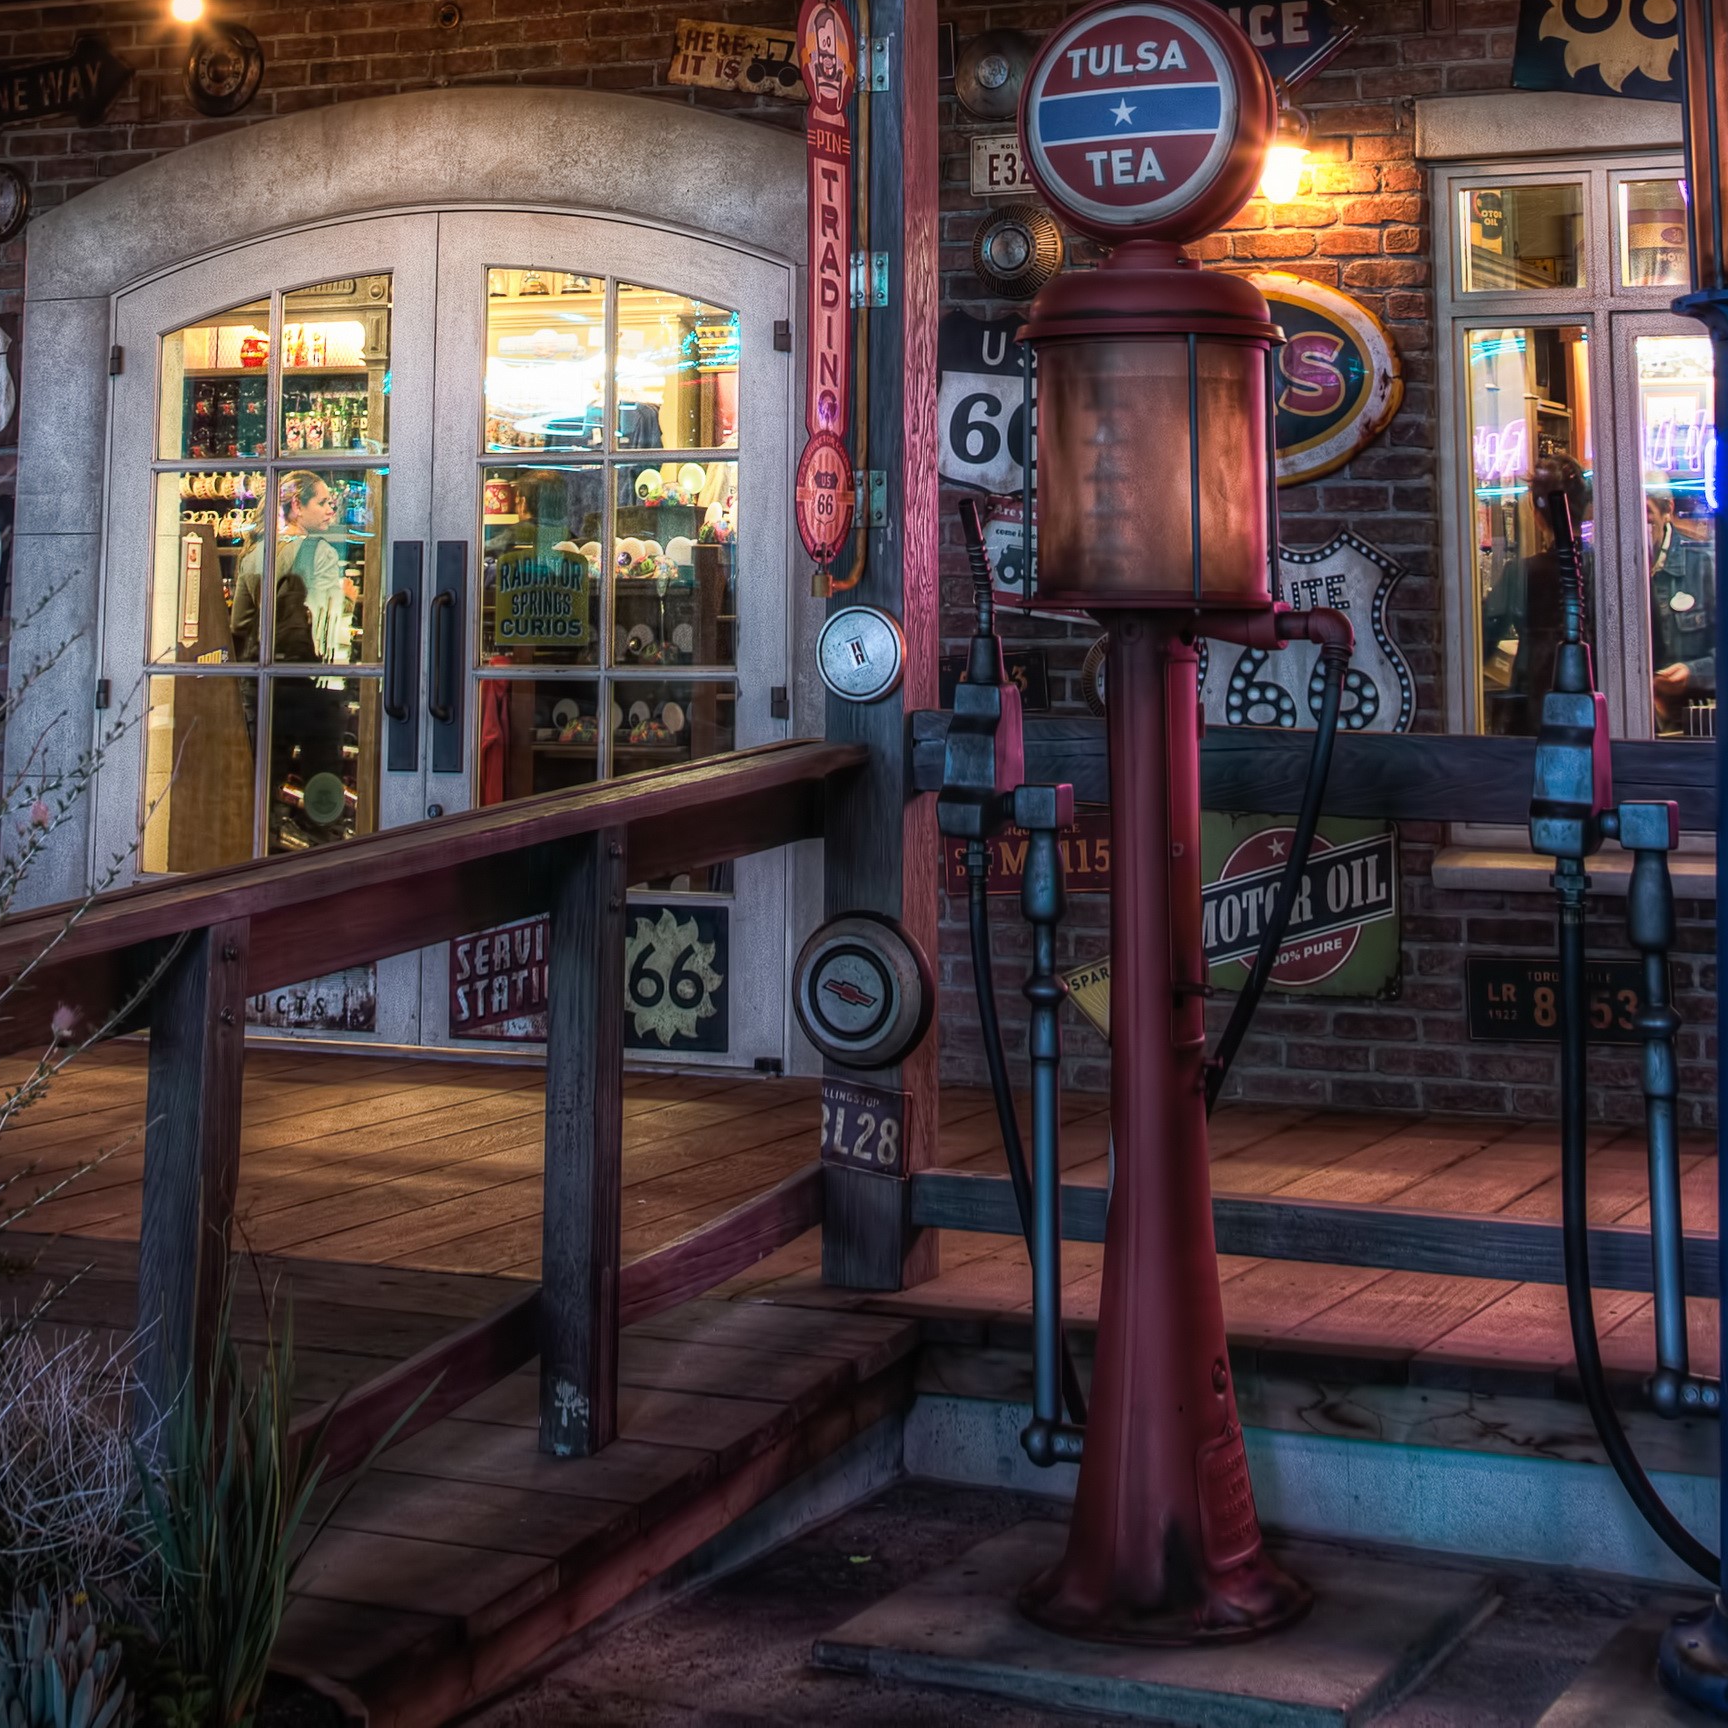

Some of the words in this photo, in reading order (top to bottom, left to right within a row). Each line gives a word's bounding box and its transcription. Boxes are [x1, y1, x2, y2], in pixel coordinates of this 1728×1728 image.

[684, 29, 747, 55] HERE
[679, 54, 705, 76] IT
[715, 57, 741, 80] IS
[1067, 39, 1189, 79] TULSA
[40, 60, 103, 108] WAY
[815, 128, 843, 155] PIN
[1085, 148, 1166, 188] TEA
[818, 166, 842, 424] TRADING
[820, 474, 832, 488] US
[817, 493, 834, 516] 66
[499, 547, 584, 592] RADIATOR
[510, 589, 573, 618] SPRINGS
[499, 617, 584, 640] CURIOS
[1325, 852, 1389, 914] OIL
[1303, 936, 1344, 960] PURE
[628, 943, 704, 1010] 66
[1486, 982, 1517, 1003] LR
